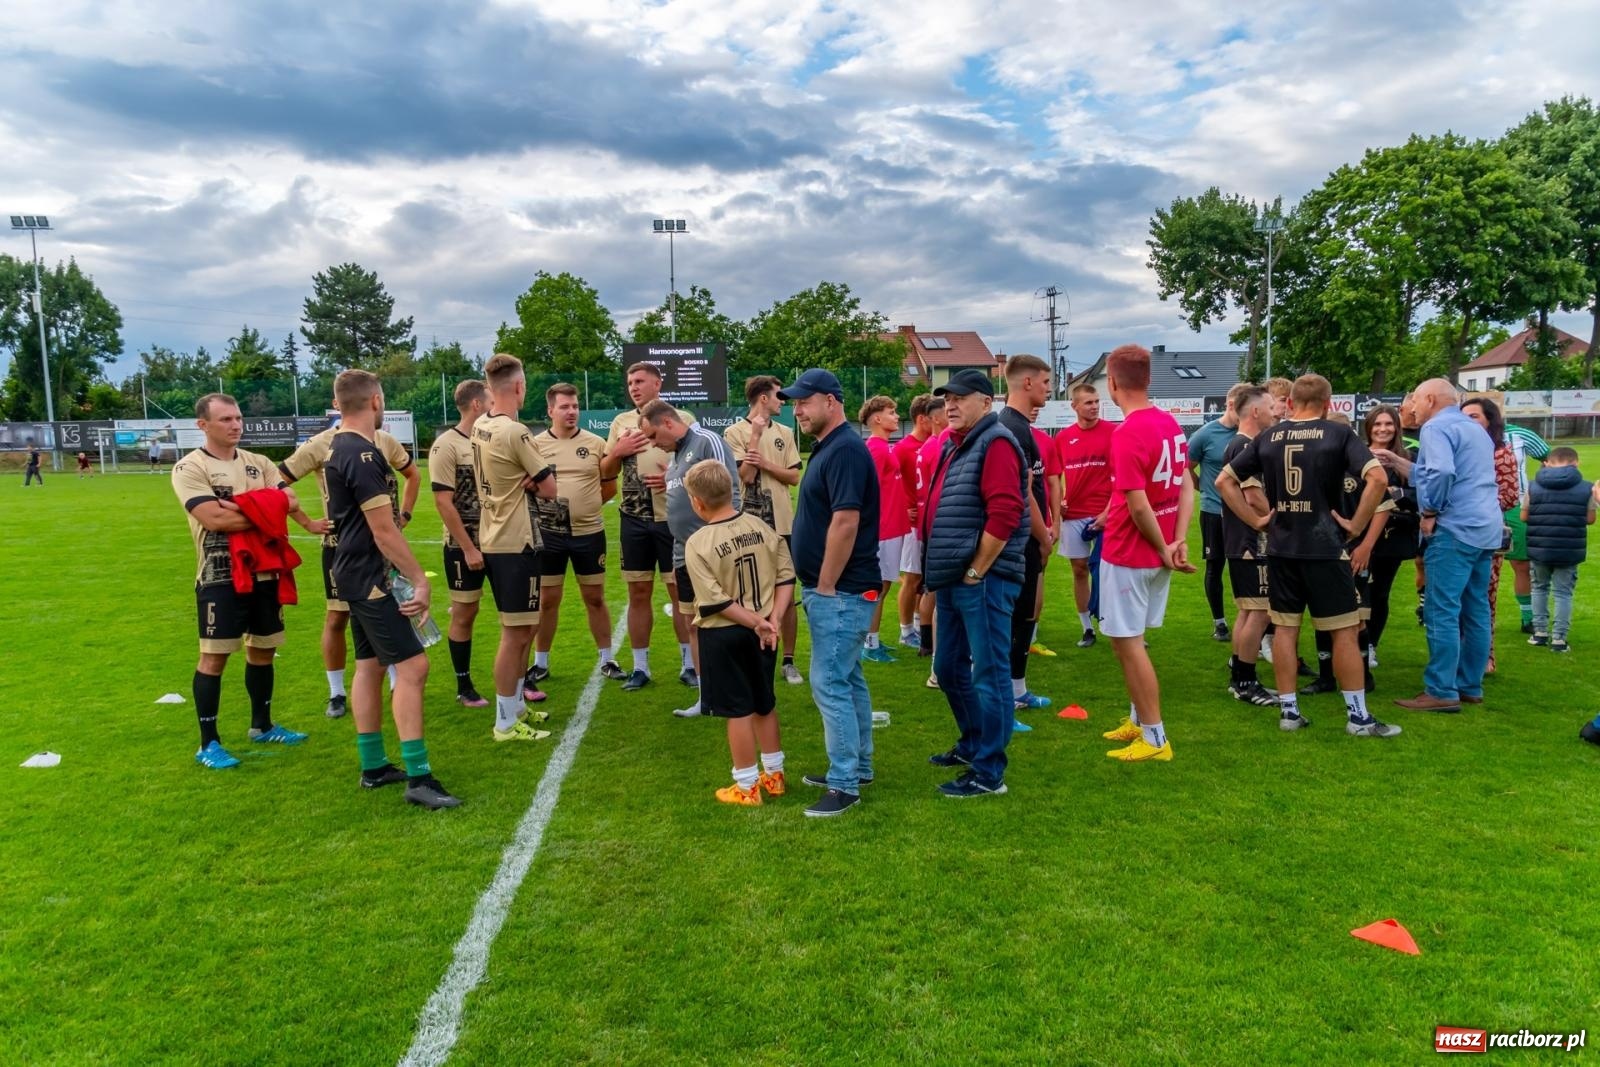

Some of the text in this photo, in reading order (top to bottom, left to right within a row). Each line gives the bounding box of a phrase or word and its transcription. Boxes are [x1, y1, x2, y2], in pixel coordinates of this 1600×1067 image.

[245, 420, 294, 431] UBILER
[588, 419, 612, 429] Nasz
[702, 417, 734, 427] Nasza
[1152, 433, 1188, 490] 45
[1284, 444, 1304, 496] 6
